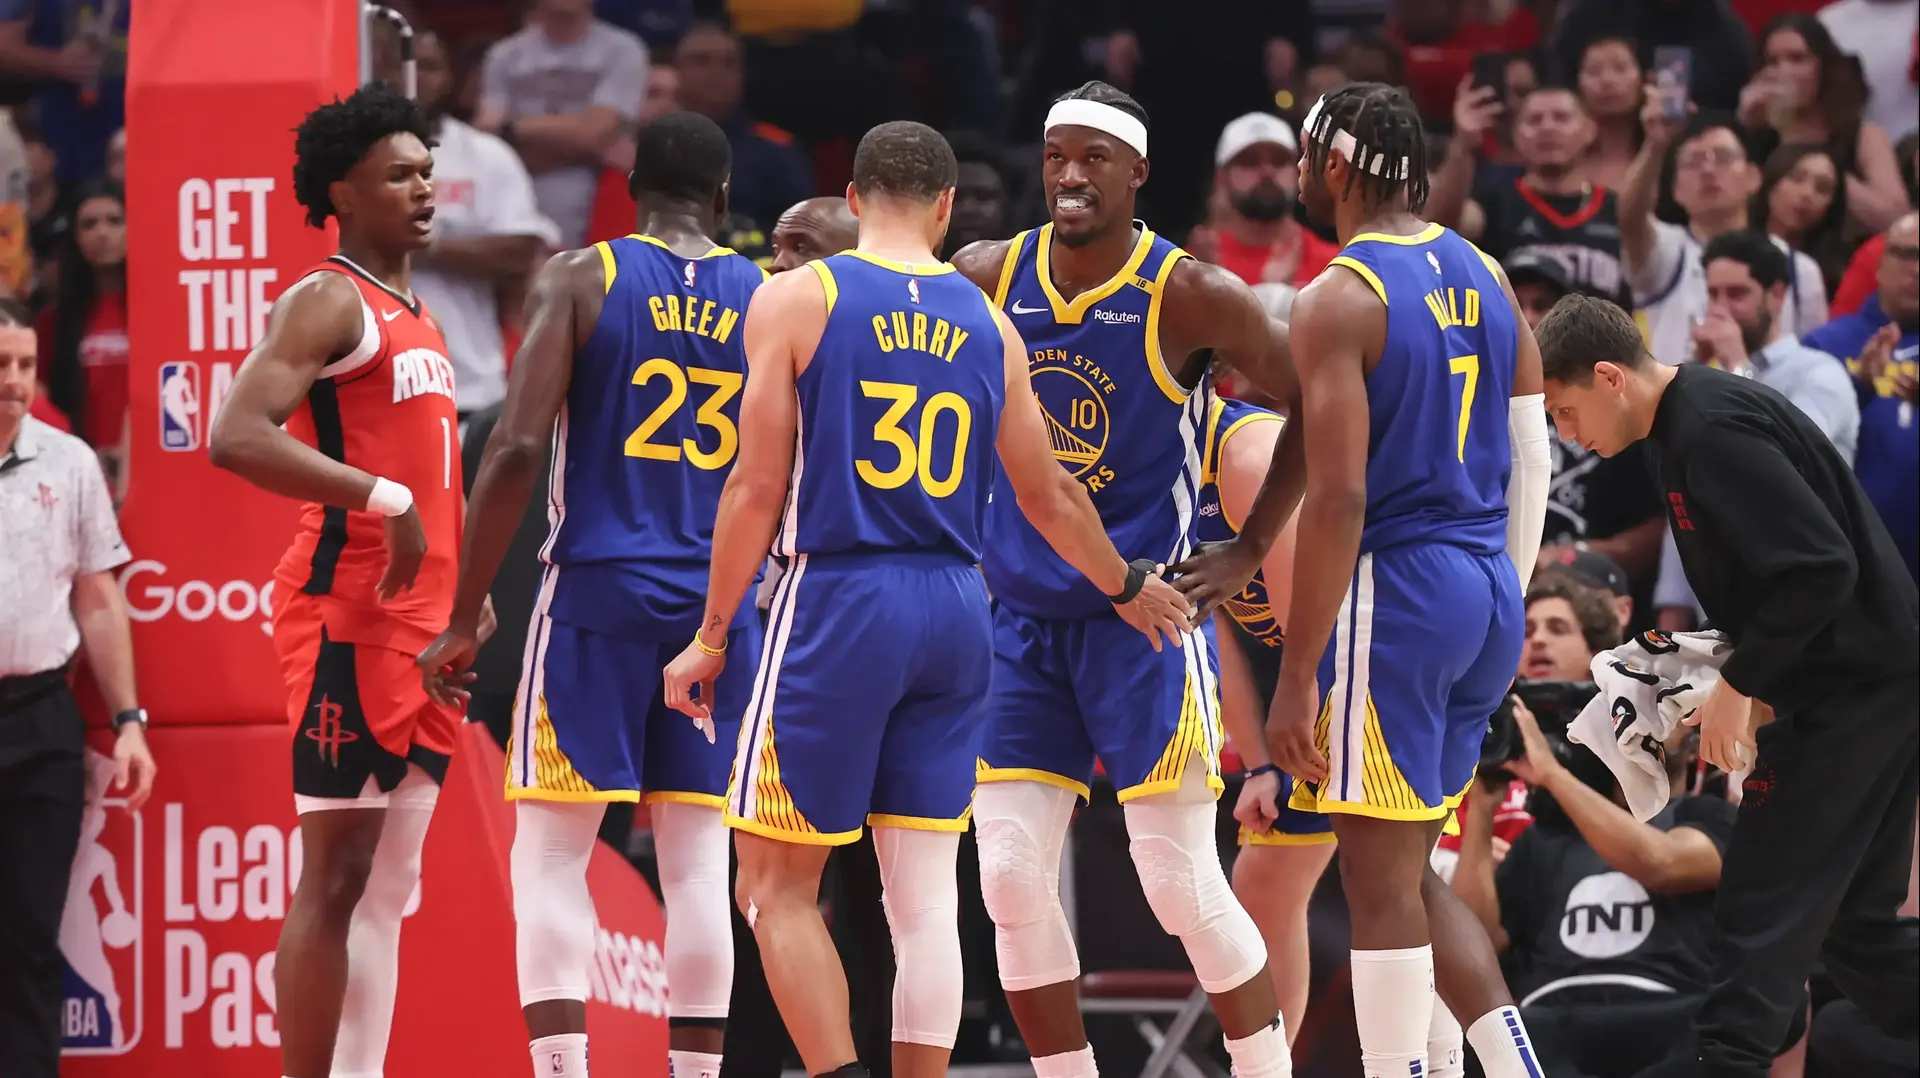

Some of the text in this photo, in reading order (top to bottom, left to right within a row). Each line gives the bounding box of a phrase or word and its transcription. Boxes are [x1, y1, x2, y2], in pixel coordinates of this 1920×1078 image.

[178, 177, 275, 261] GET
[178, 268, 278, 351] THE
[1136, 279, 1147, 288] 16
[648, 294, 740, 344] GREEN
[872, 311, 969, 363] CURRY
[1094, 309, 1140, 324] Rakuten
[1073, 355, 1116, 394] STATE
[624, 358, 744, 470] 23
[1070, 398, 1097, 430] 10
[1449, 354, 1480, 464] 7
[441, 416, 451, 489] 1
[855, 380, 971, 498] 30
[1565, 901, 1651, 936] TNT
